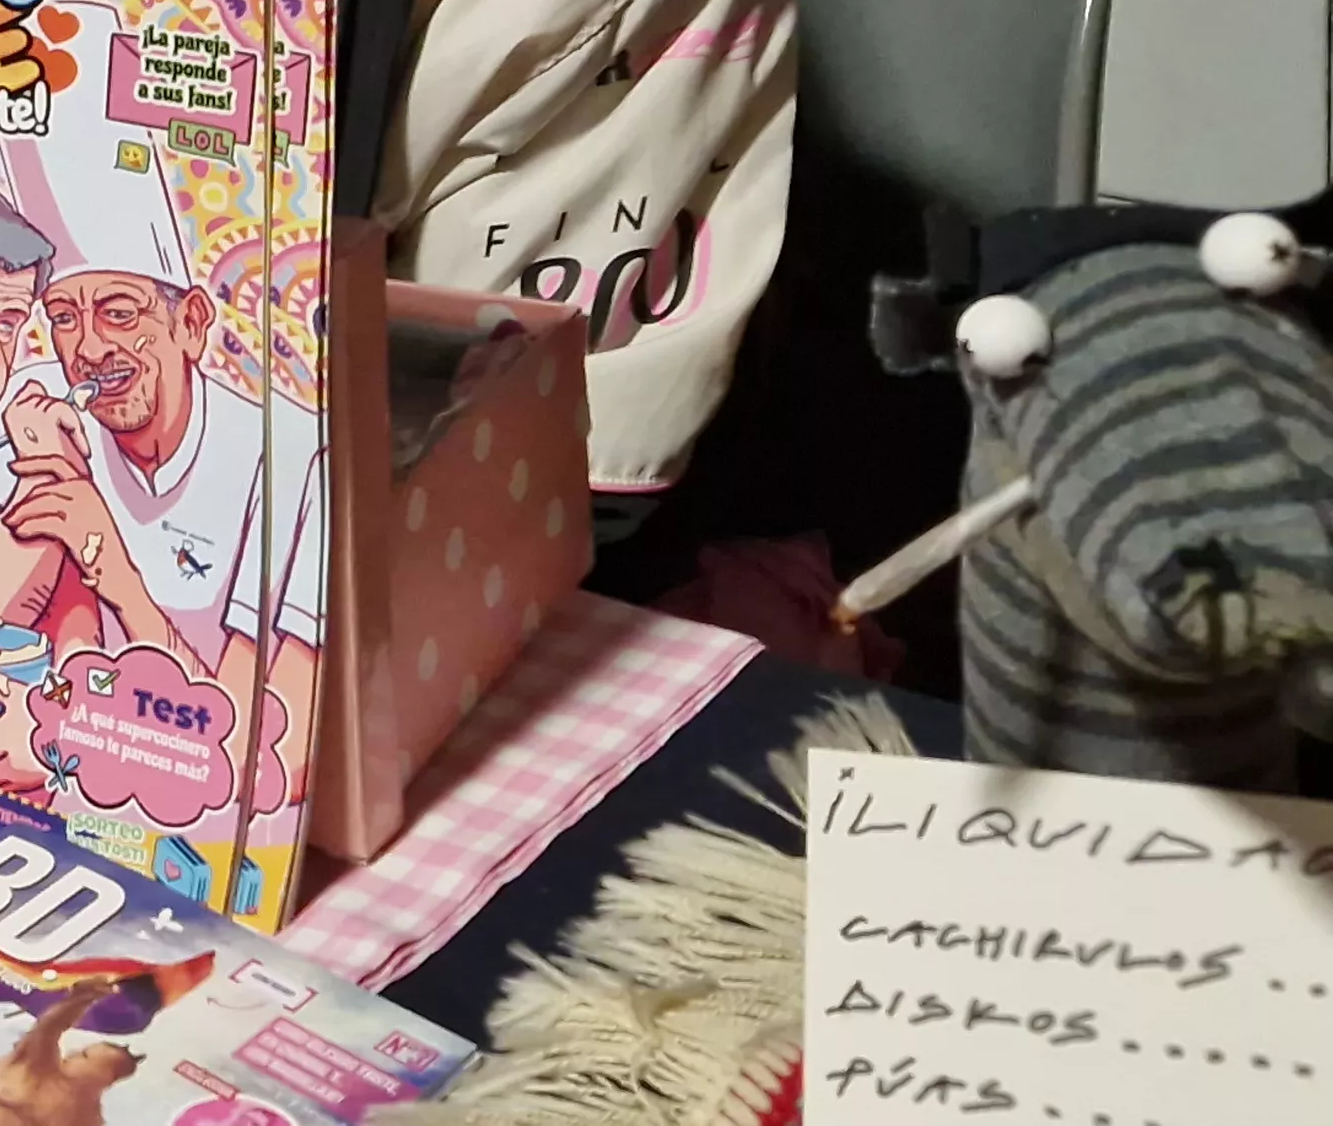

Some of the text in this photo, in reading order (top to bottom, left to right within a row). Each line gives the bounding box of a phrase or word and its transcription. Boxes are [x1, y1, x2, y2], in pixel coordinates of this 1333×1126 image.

[142, 26, 230, 61] ¡La pareja
[144, 55, 227, 84] responde
[138, 85, 233, 113] a sus fans!
[175, 128, 232, 157] LOL
[132, 687, 213, 736] Test
[59, 723, 105, 754] famoso
[120, 741, 173, 777] pareces
[116, 718, 212, 761] supercocinero
